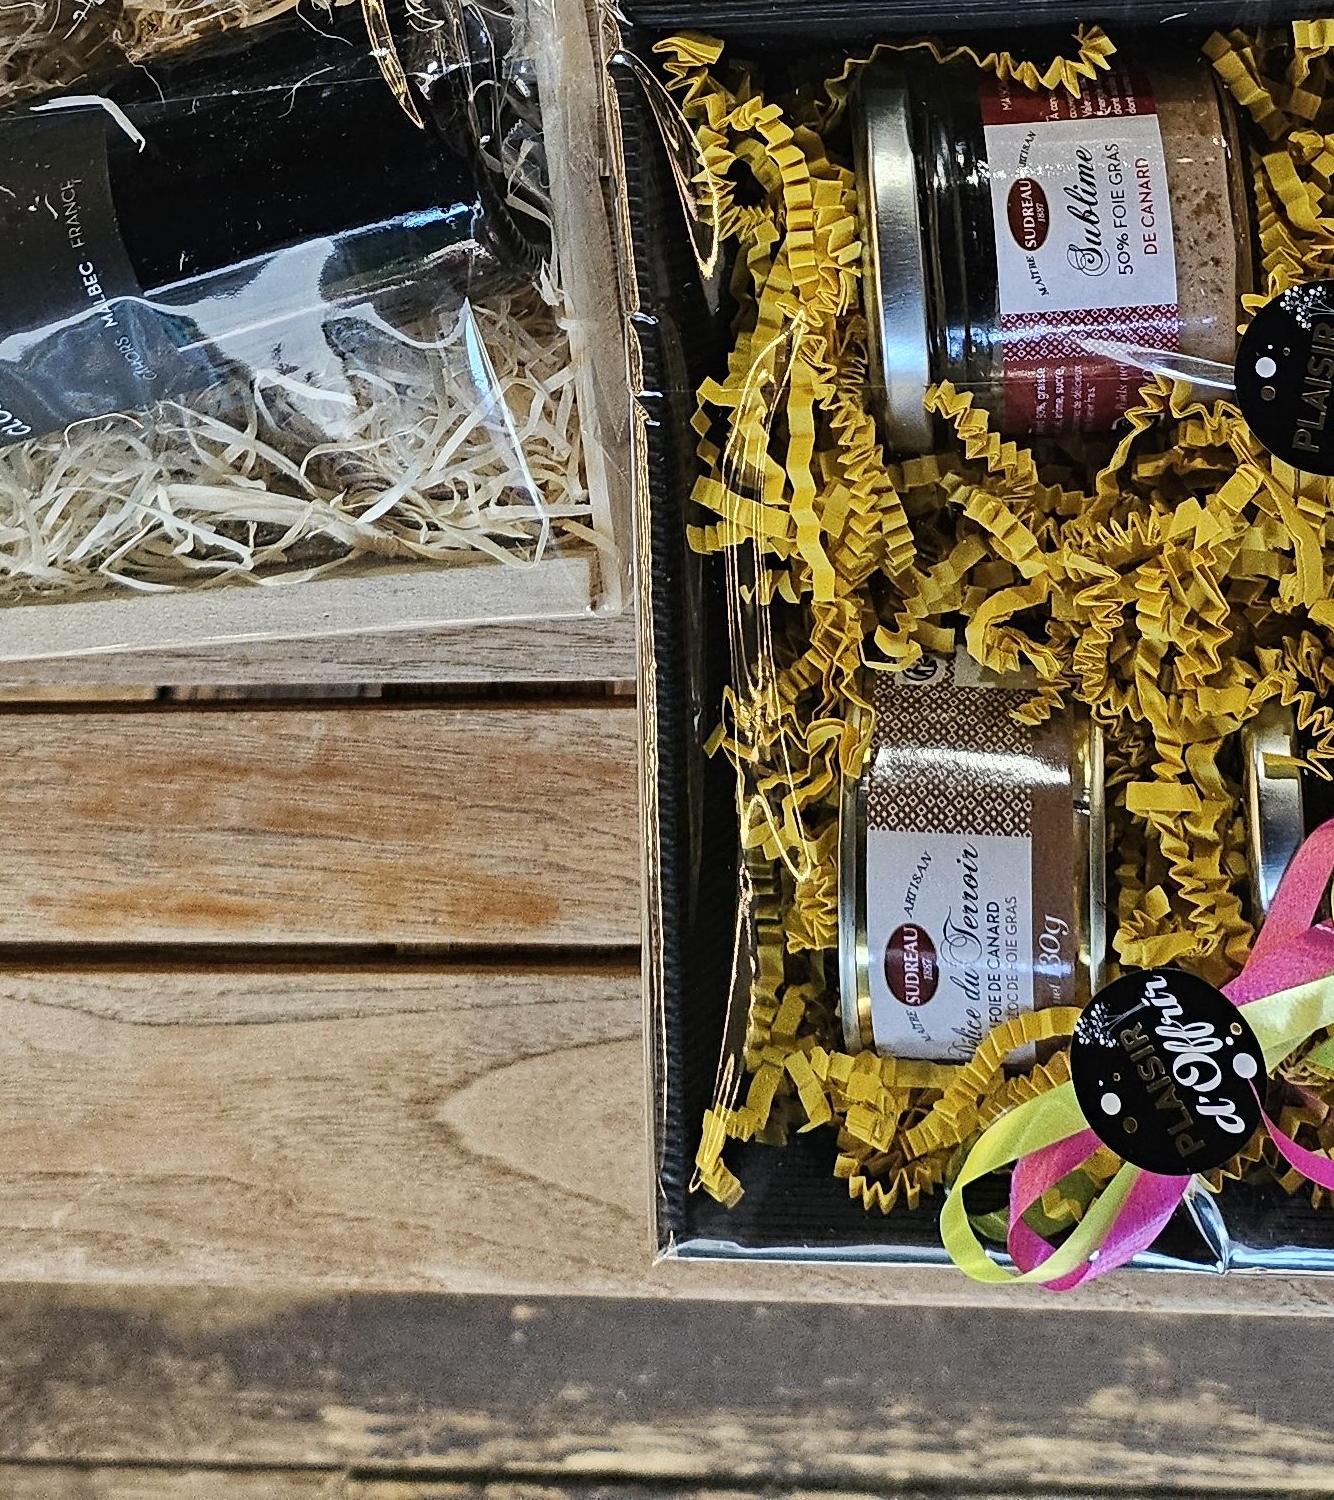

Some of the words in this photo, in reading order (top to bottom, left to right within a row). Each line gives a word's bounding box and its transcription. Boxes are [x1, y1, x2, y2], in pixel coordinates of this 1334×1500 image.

[1105, 143, 1122, 185] GRAS
[1036, 202, 1046, 222] 1887
[1063, 145, 1111, 276] Sublime
[1110, 189, 1127, 228] FOIE
[1134, 157, 1155, 228] CANARD
[60, 180, 85, 248] FRANCE
[1019, 180, 1037, 248] SUDREAU
[1116, 233, 1133, 275] 50%
[1142, 233, 1157, 255] DE
[79, 261, 119, 328] MALBEC
[1025, 255, 1050, 296] MAÎTRE
[1034, 367, 1049, 400] graisse
[903, 850, 932, 918] ARTISAN
[940, 842, 982, 965] Terroir
[986, 902, 1000, 970] CANARD
[1005, 896, 1018, 935] GRAS
[903, 926, 921, 1005] SUDREAU
[922, 957, 934, 980] 1887
[950, 968, 981, 1001] du
[988, 973, 1001, 992] DE
[1006, 974, 1019, 991] DE
[988, 995, 1003, 1023] FOIE
[1141, 975, 1246, 1134] d'Offrir
[1120, 1022, 1206, 1158] PLAISIR
